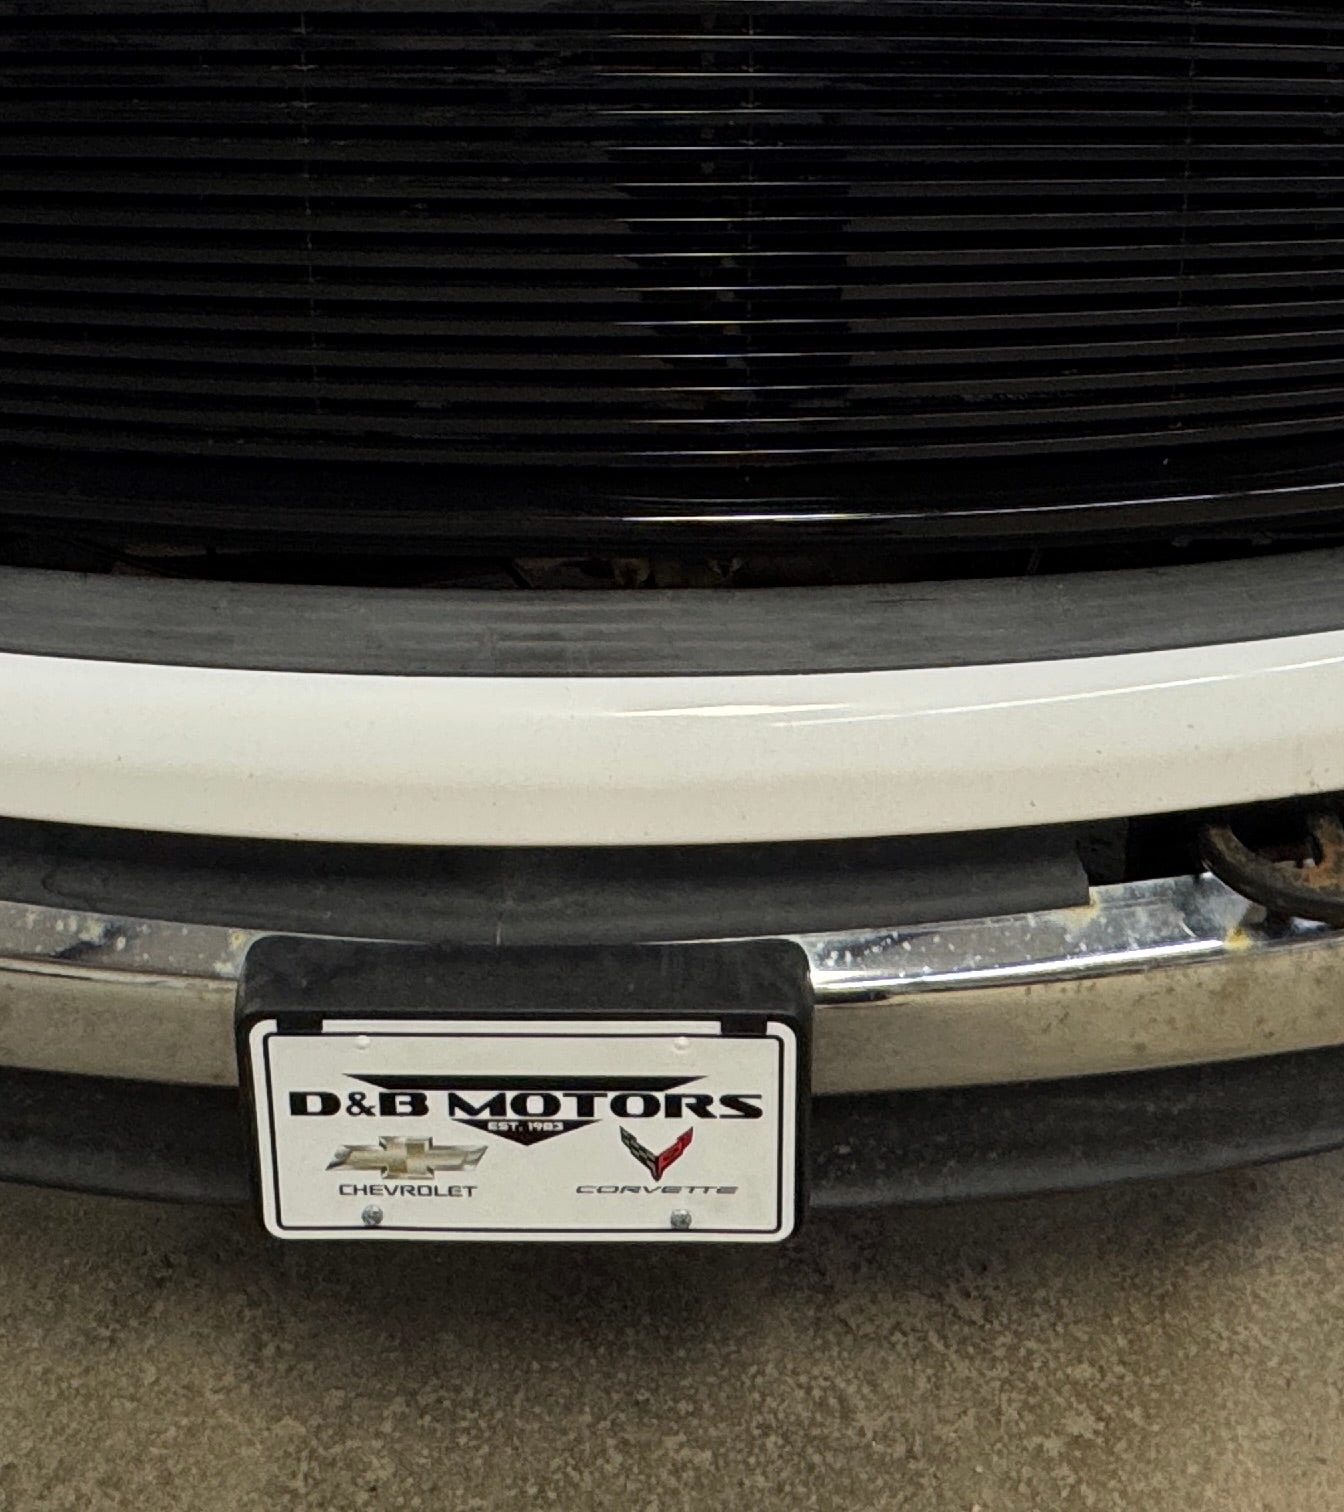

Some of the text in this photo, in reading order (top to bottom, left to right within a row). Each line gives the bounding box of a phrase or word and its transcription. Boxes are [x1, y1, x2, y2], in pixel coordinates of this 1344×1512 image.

[289, 1090, 763, 1120] D&B MOTORS
[488, 1121, 524, 1131] EST.
[338, 1184, 477, 1198] CHEVROLET
[576, 1185, 739, 1194] CORVETTE
